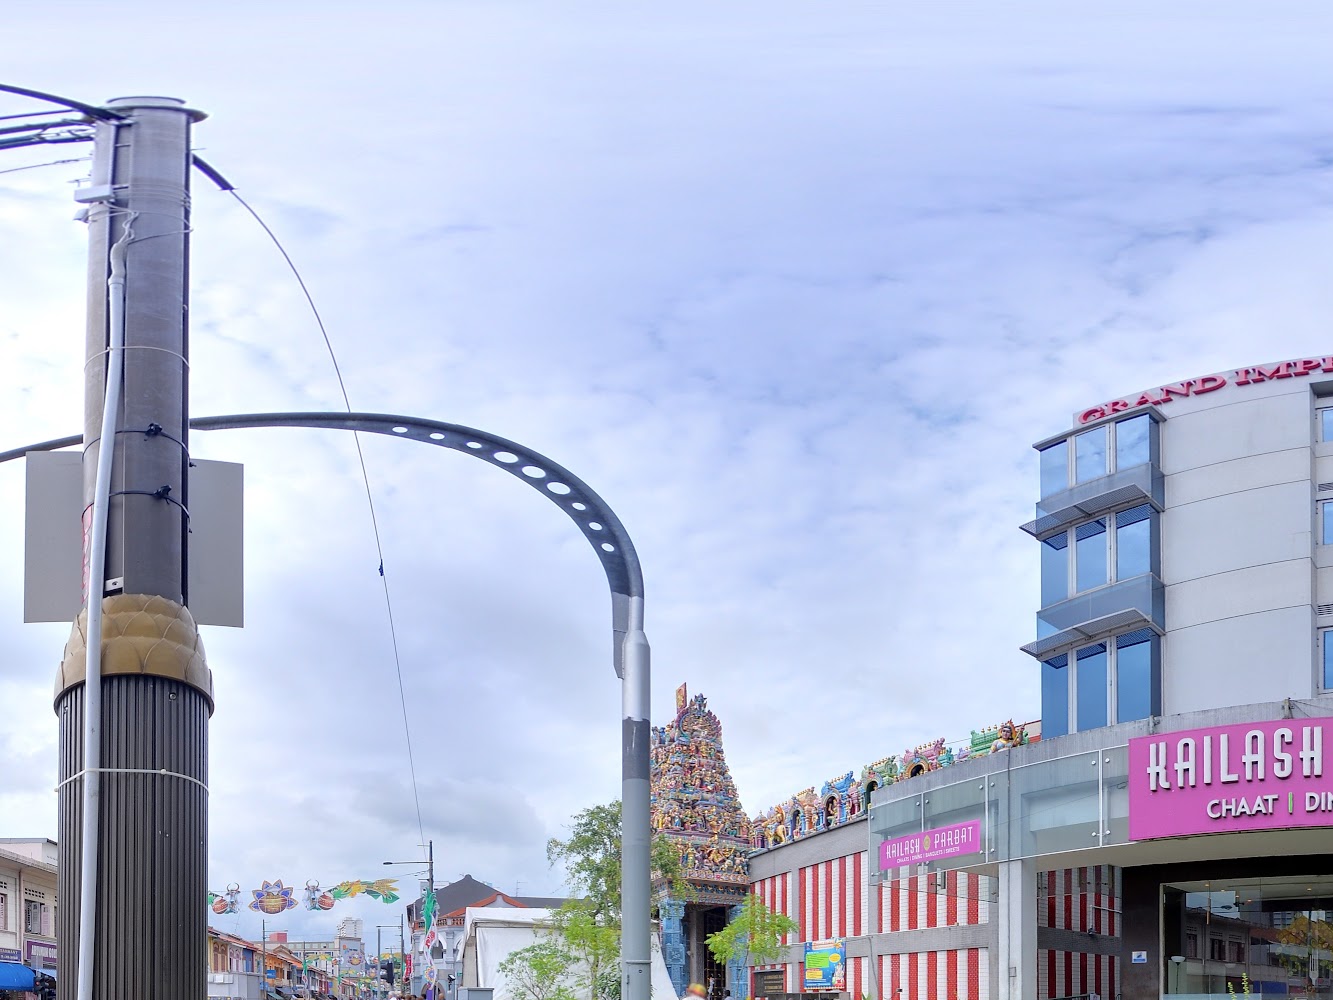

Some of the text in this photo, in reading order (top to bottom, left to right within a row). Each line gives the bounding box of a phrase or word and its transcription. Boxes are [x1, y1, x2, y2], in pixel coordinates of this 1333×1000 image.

[1078, 376, 1227, 425] GRAND
[1147, 726, 1322, 791] KAILASH
[1207, 794, 1279, 818] CHAAT
[886, 826, 973, 859] KAILASH PARBAT
